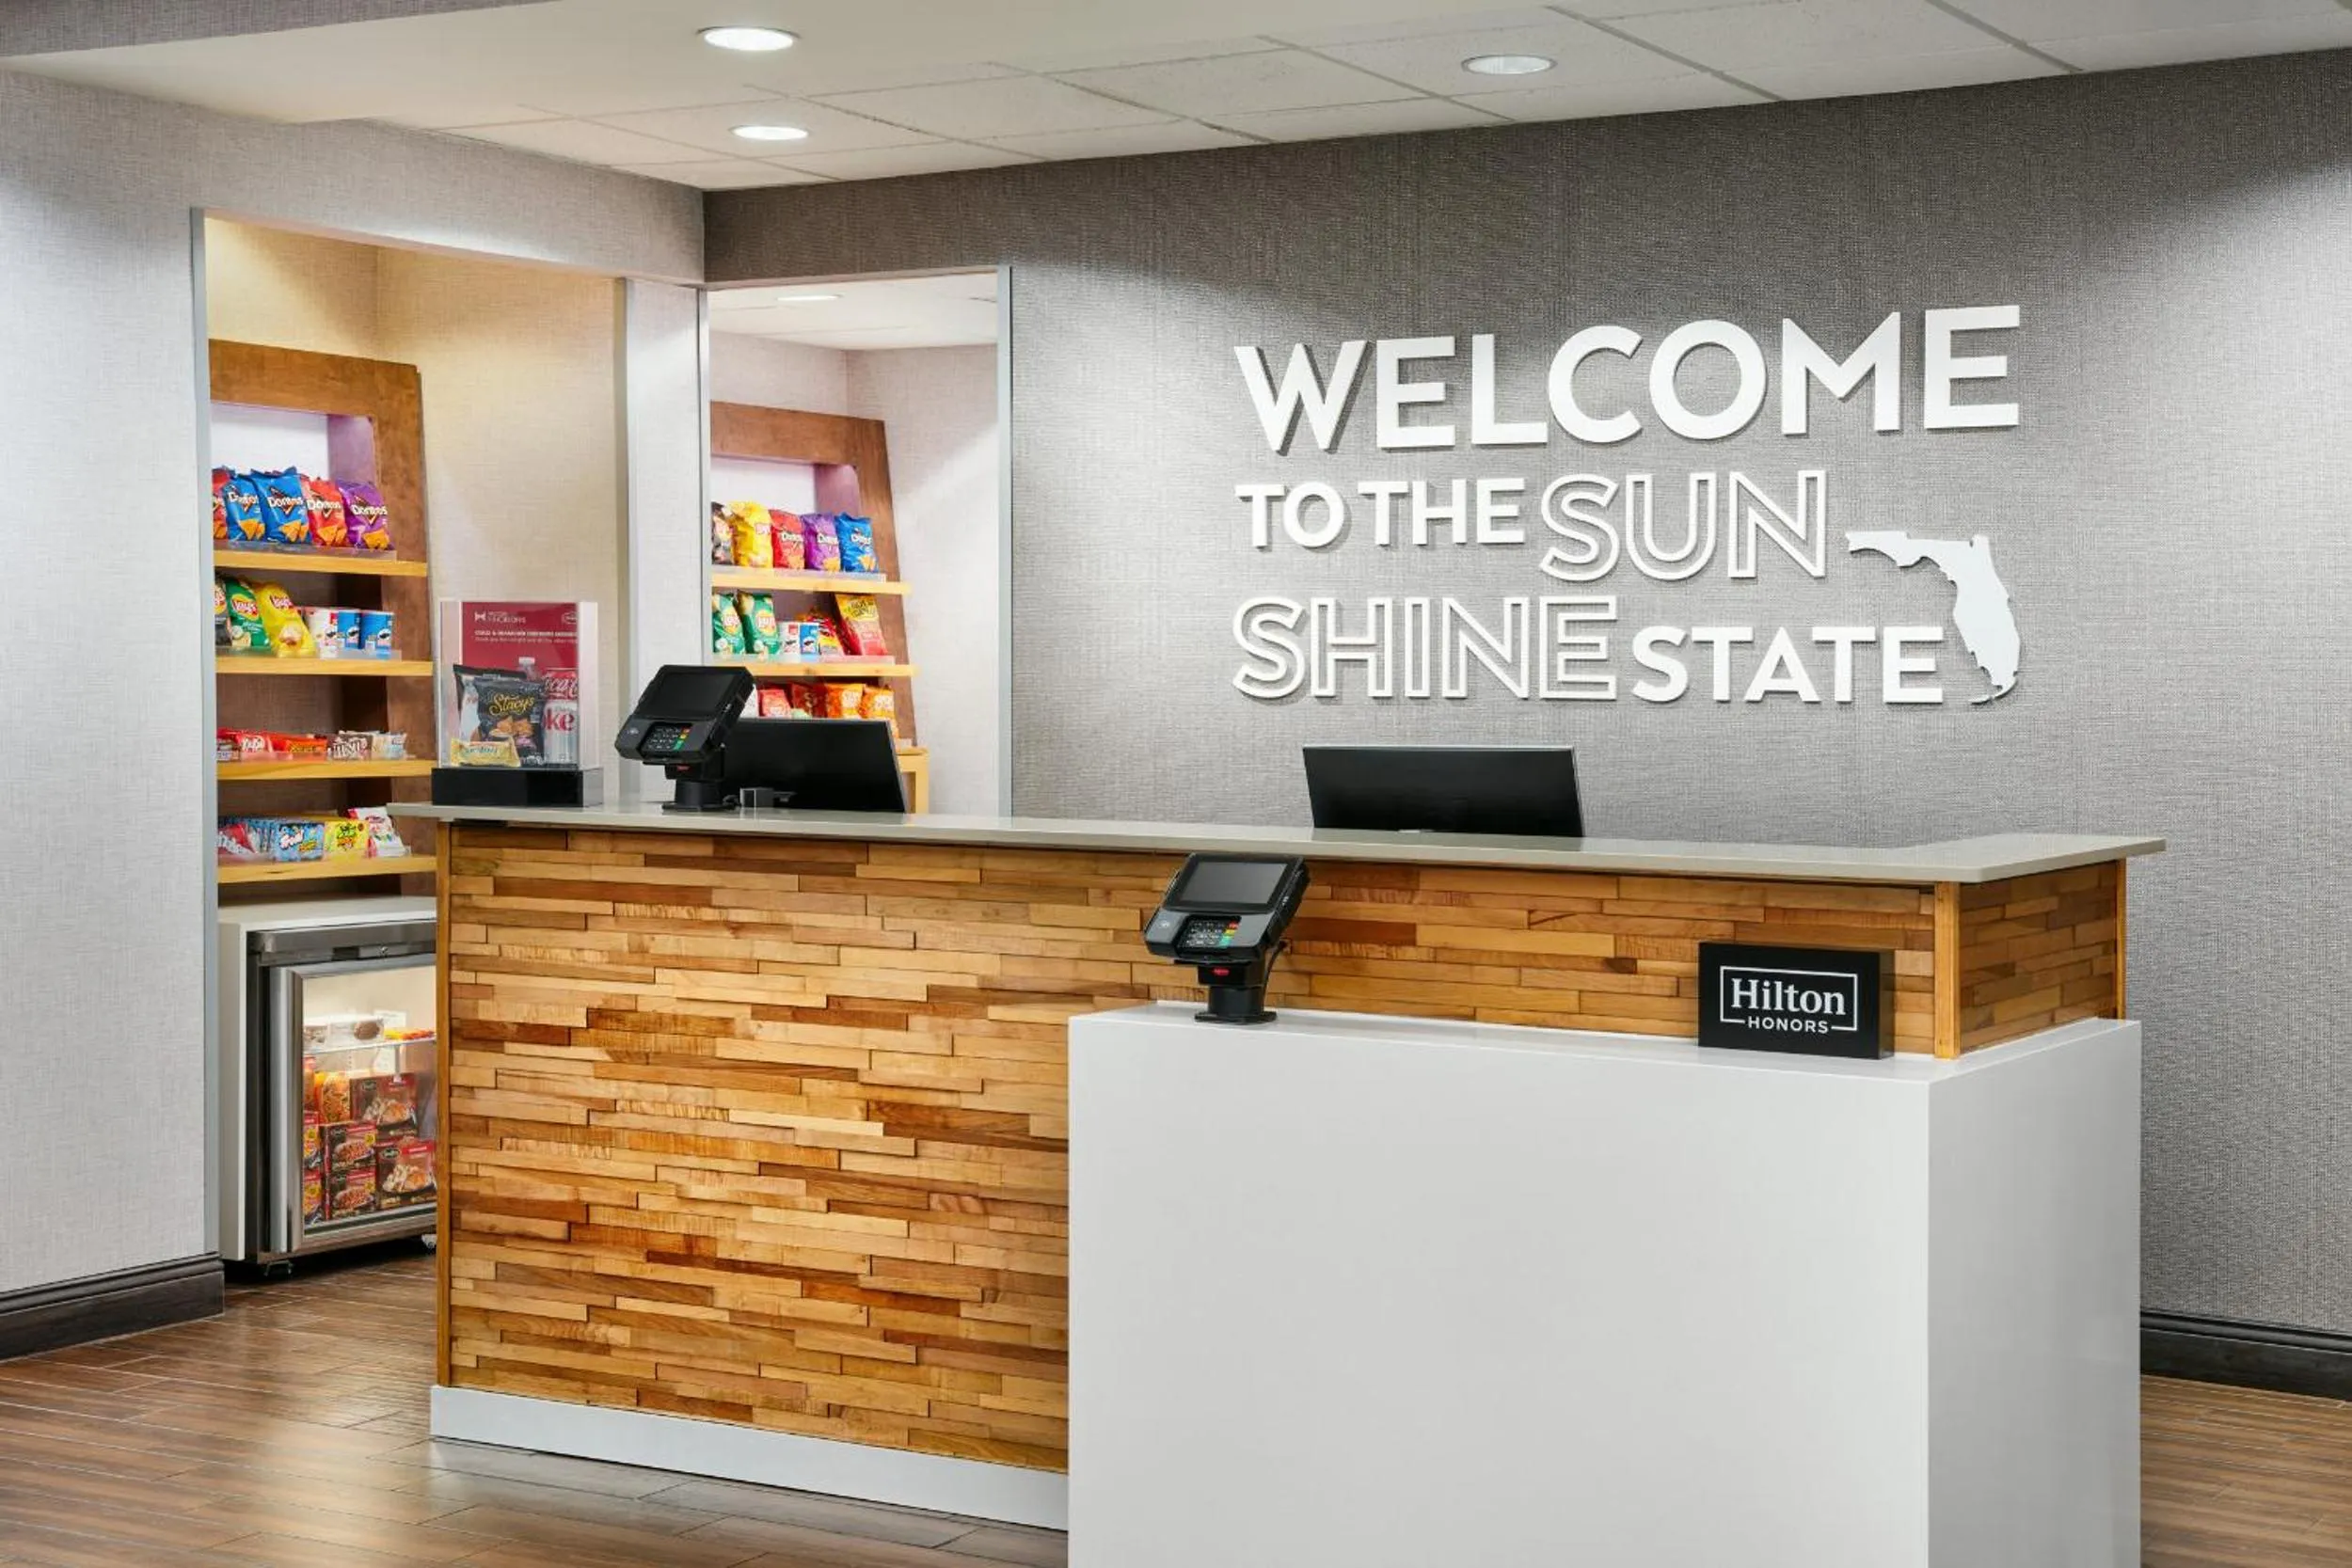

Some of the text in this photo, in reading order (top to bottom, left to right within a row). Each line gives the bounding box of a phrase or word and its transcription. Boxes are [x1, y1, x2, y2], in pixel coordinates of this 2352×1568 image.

[1233, 305, 2020, 451] WELCOME
[1235, 469, 1827, 582] TO THE SUN
[1232, 596, 1944, 704] SHINE STATE
[489, 693, 534, 716] Stacy's
[545, 708, 575, 731] ke
[1731, 977, 1846, 1015] Hilton
[1748, 1016, 1829, 1034] HONORS
